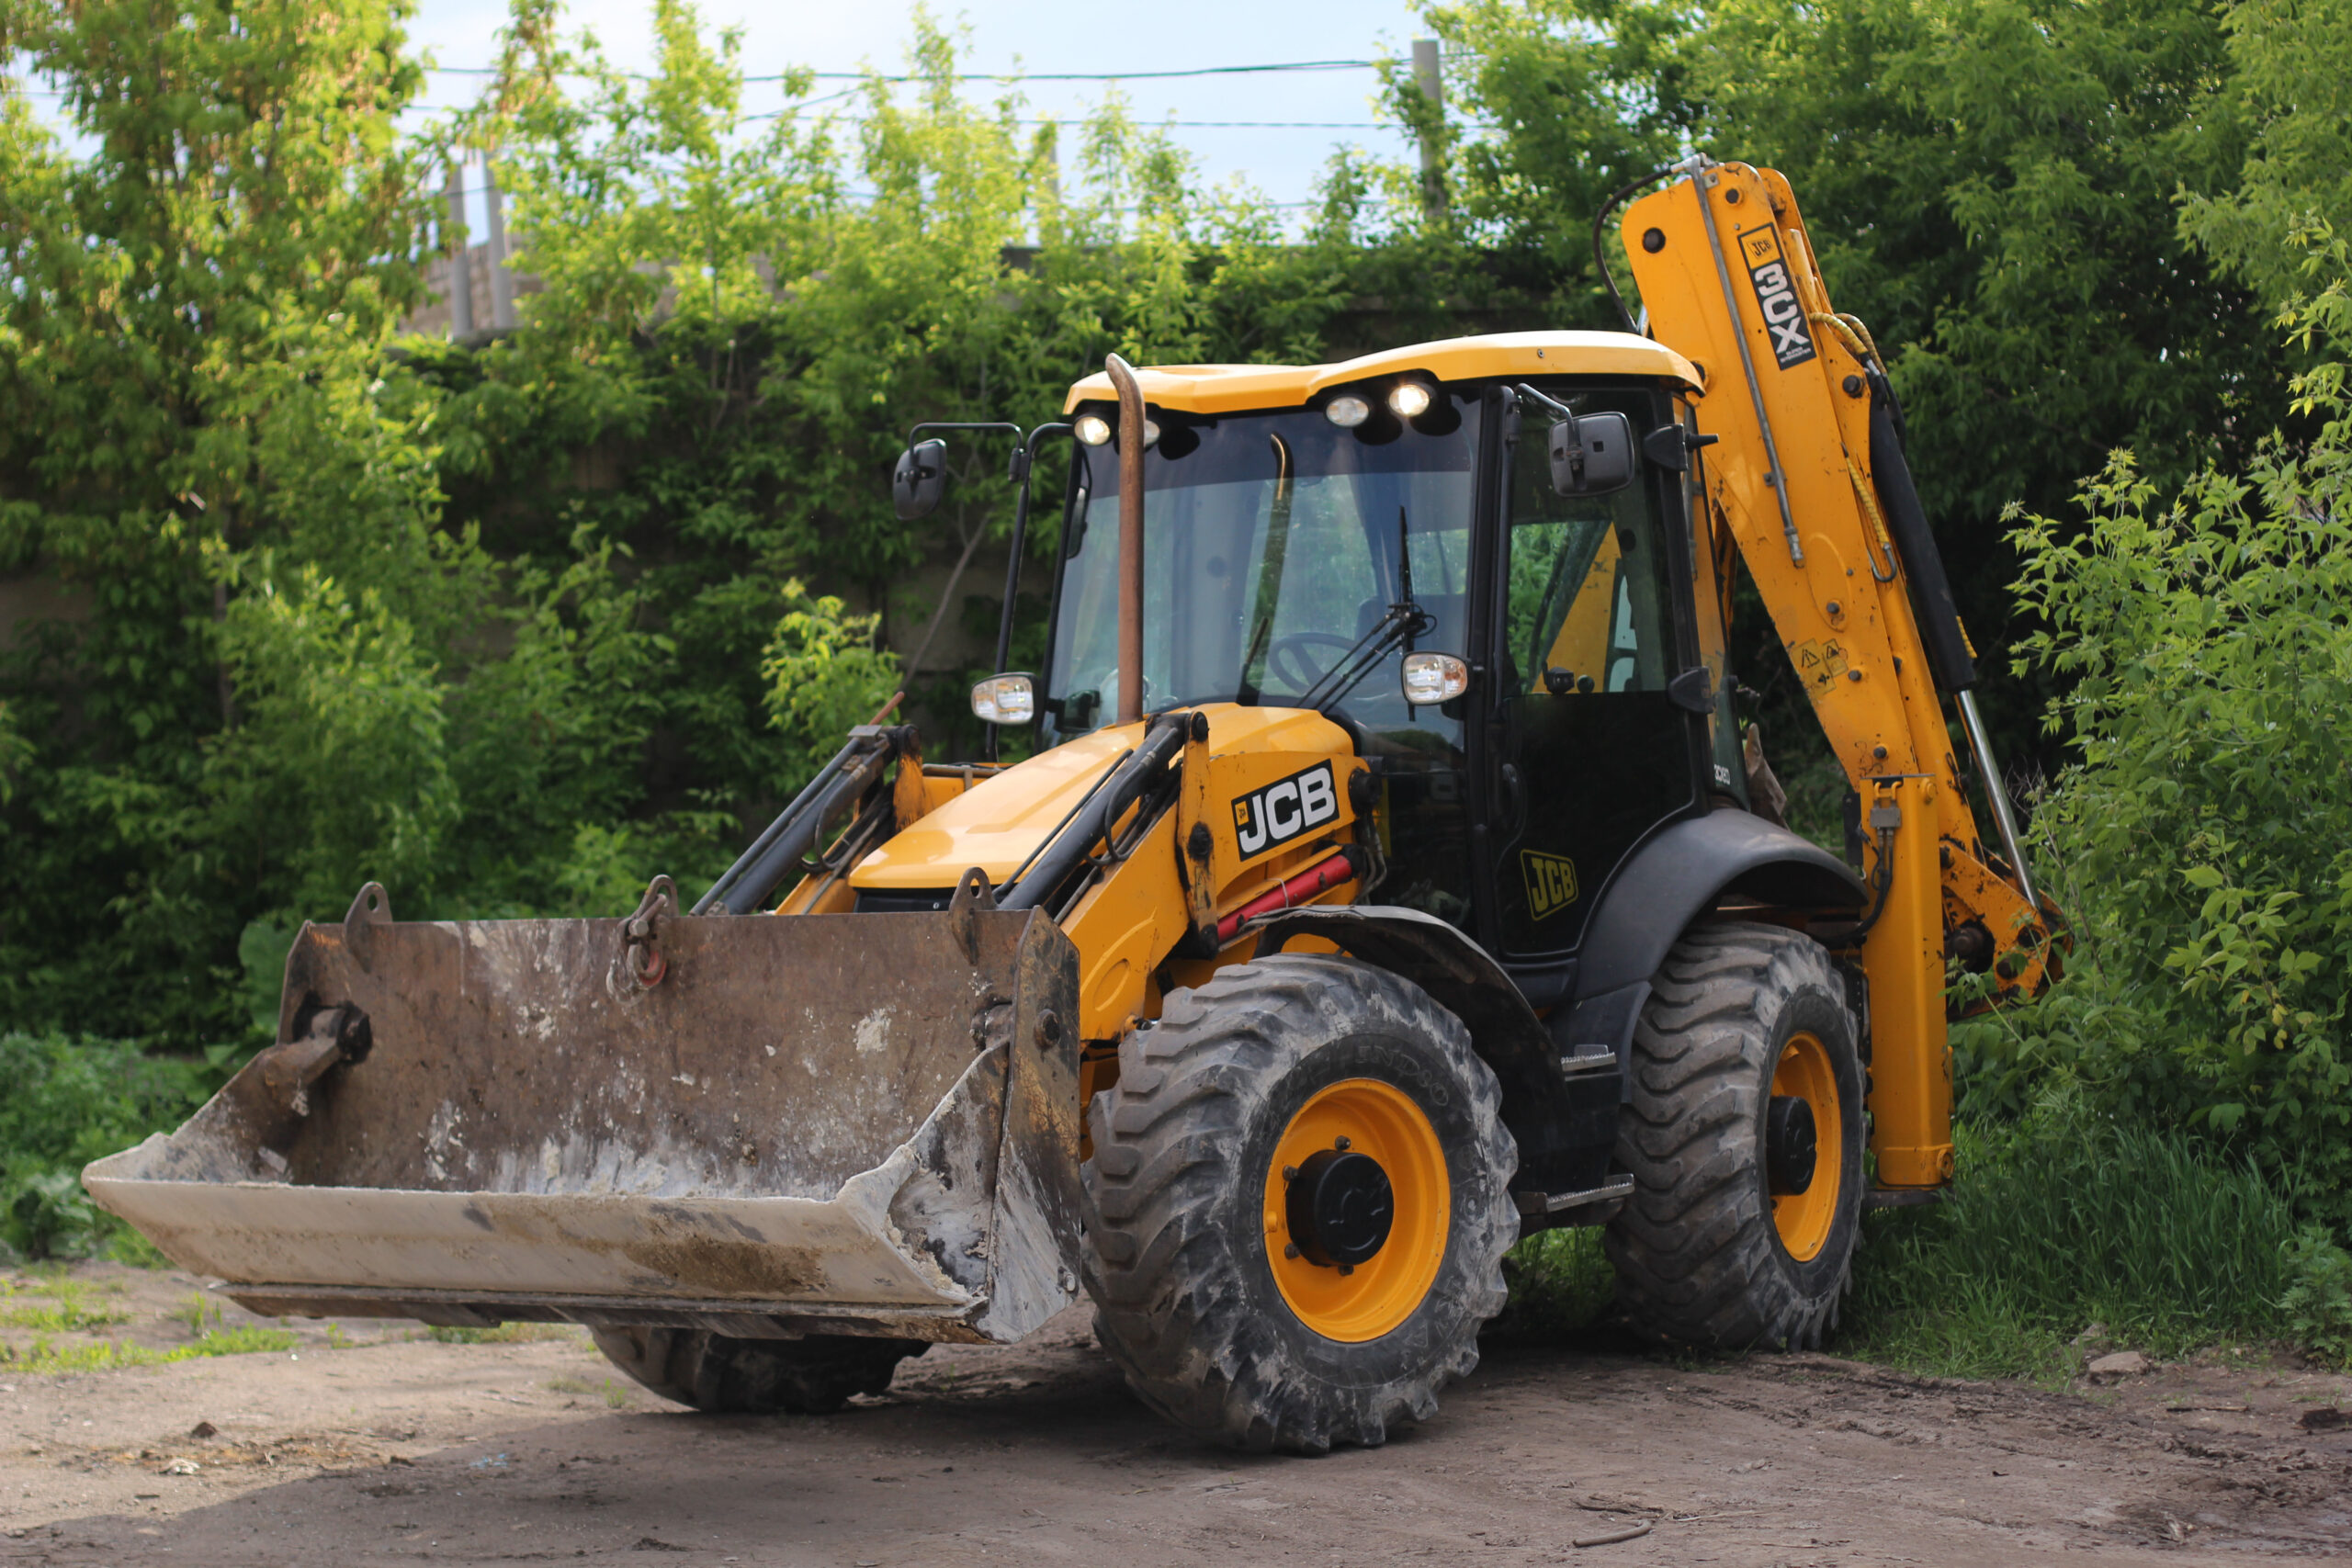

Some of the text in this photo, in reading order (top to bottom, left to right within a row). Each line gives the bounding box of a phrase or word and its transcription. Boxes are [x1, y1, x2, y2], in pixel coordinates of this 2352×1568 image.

[1751, 240, 1771, 256] JCB
[1755, 263, 1810, 354] 3CX
[1238, 767, 1336, 853] JCB
[1531, 857, 1576, 912] JCB
